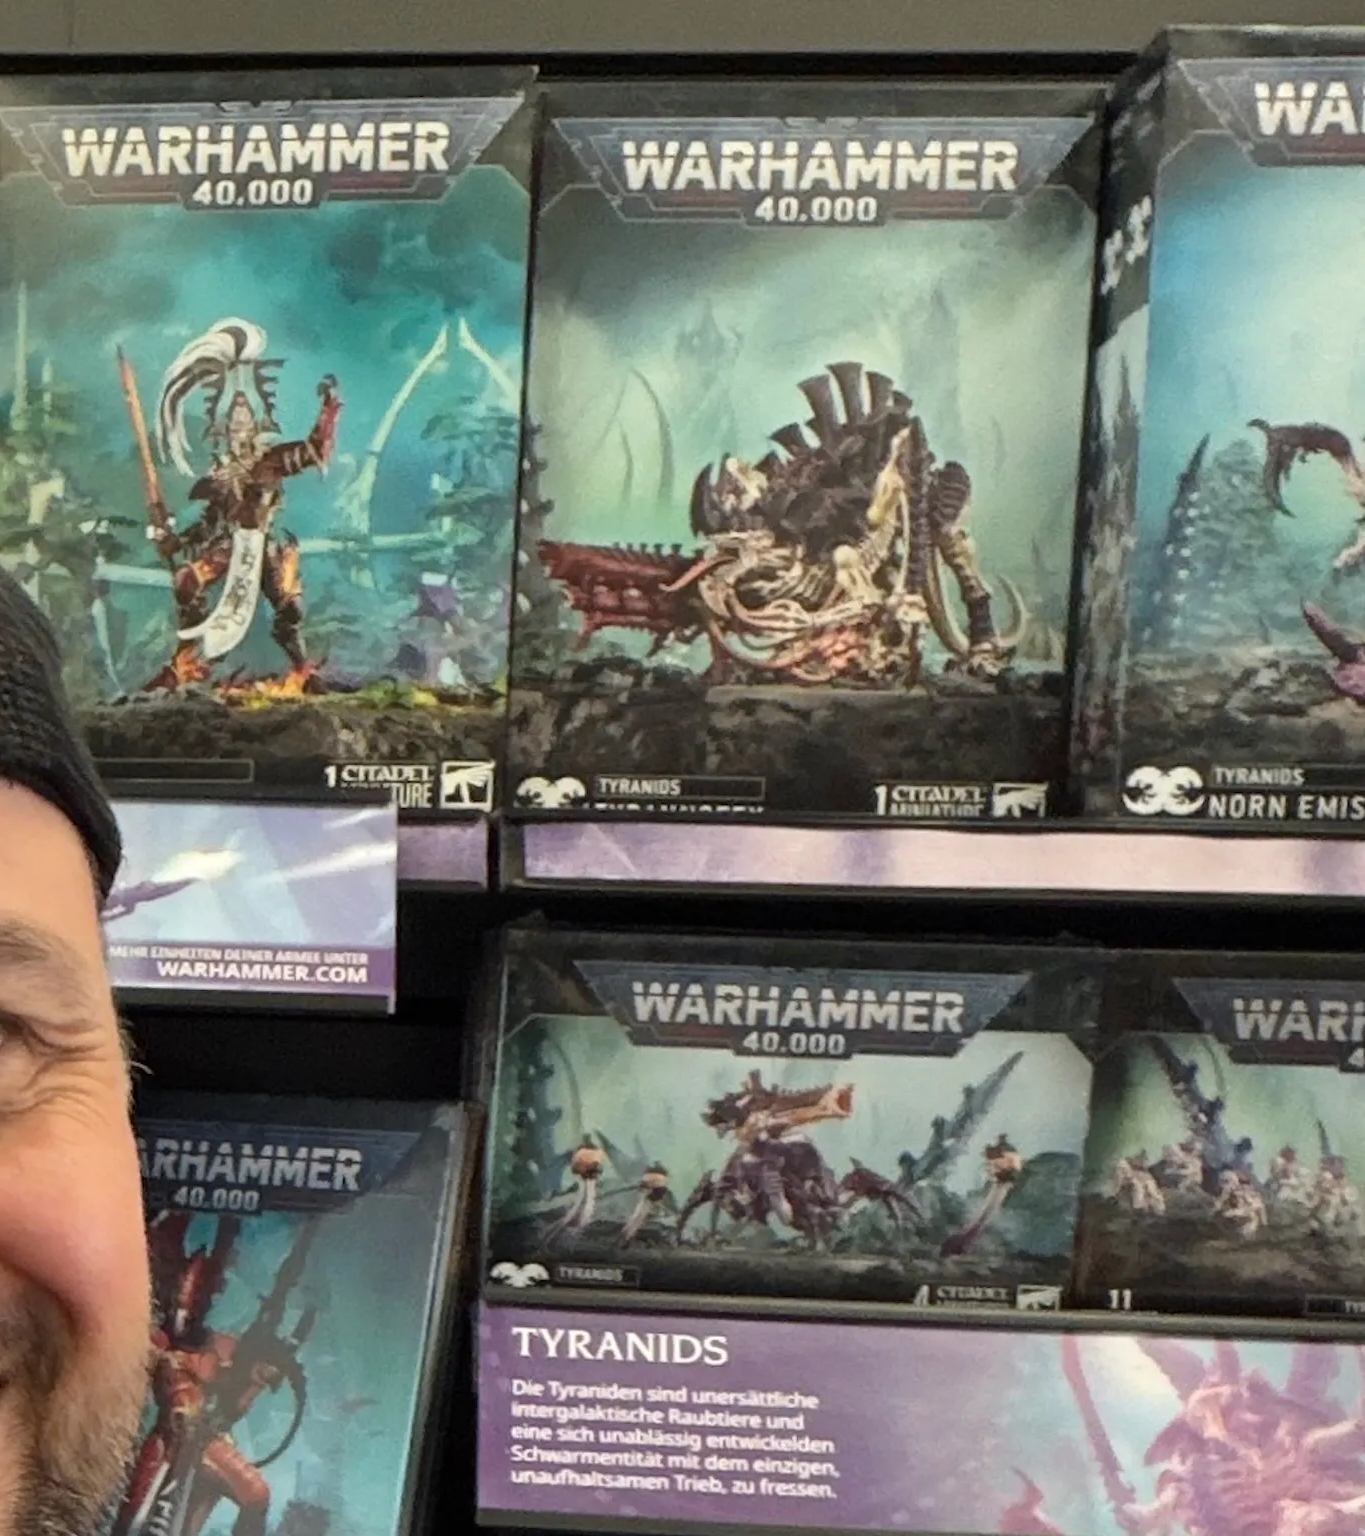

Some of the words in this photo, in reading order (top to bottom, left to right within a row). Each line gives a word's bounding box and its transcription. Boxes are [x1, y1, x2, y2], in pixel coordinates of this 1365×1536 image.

[63, 122, 451, 176] WARHAMMER
[623, 141, 1019, 191] WARHAMMER
[325, 765, 336, 788] 1
[341, 765, 434, 782] CITADEL
[599, 778, 681, 795] TYRANIDS
[1214, 768, 1305, 786] TYRANIDS
[874, 785, 887, 816] 1
[891, 786, 987, 802] CITADEL
[1207, 795, 1286, 819] NORN
[157, 960, 368, 983] WARHAMMER.COM
[631, 980, 965, 1034] WARHAMMER
[512, 1327, 729, 1366] TYRANIDS
[512, 1380, 544, 1398] Die
[548, 1381, 643, 1405] Tyraniden
[646, 1386, 688, 1403] sind
[691, 1388, 820, 1410] unersättliche
[512, 1402, 665, 1427] intergalaktische
[668, 1409, 763, 1429] Raubtiere
[767, 1413, 805, 1431] und
[512, 1424, 553, 1442] eine
[556, 1426, 595, 1443] sich
[598, 1428, 702, 1451] unablässig
[512, 1446, 664, 1468] Schwarmentität
[668, 1452, 701, 1470] mit
[705, 1455, 749, 1473] dem
[753, 1457, 841, 1479] einzigen,
[512, 1468, 669, 1491] unaufhaltsamen
[674, 1475, 728, 1495] Trieb,
[731, 1479, 755, 1495] zu
[759, 1478, 837, 1499] fressen.
